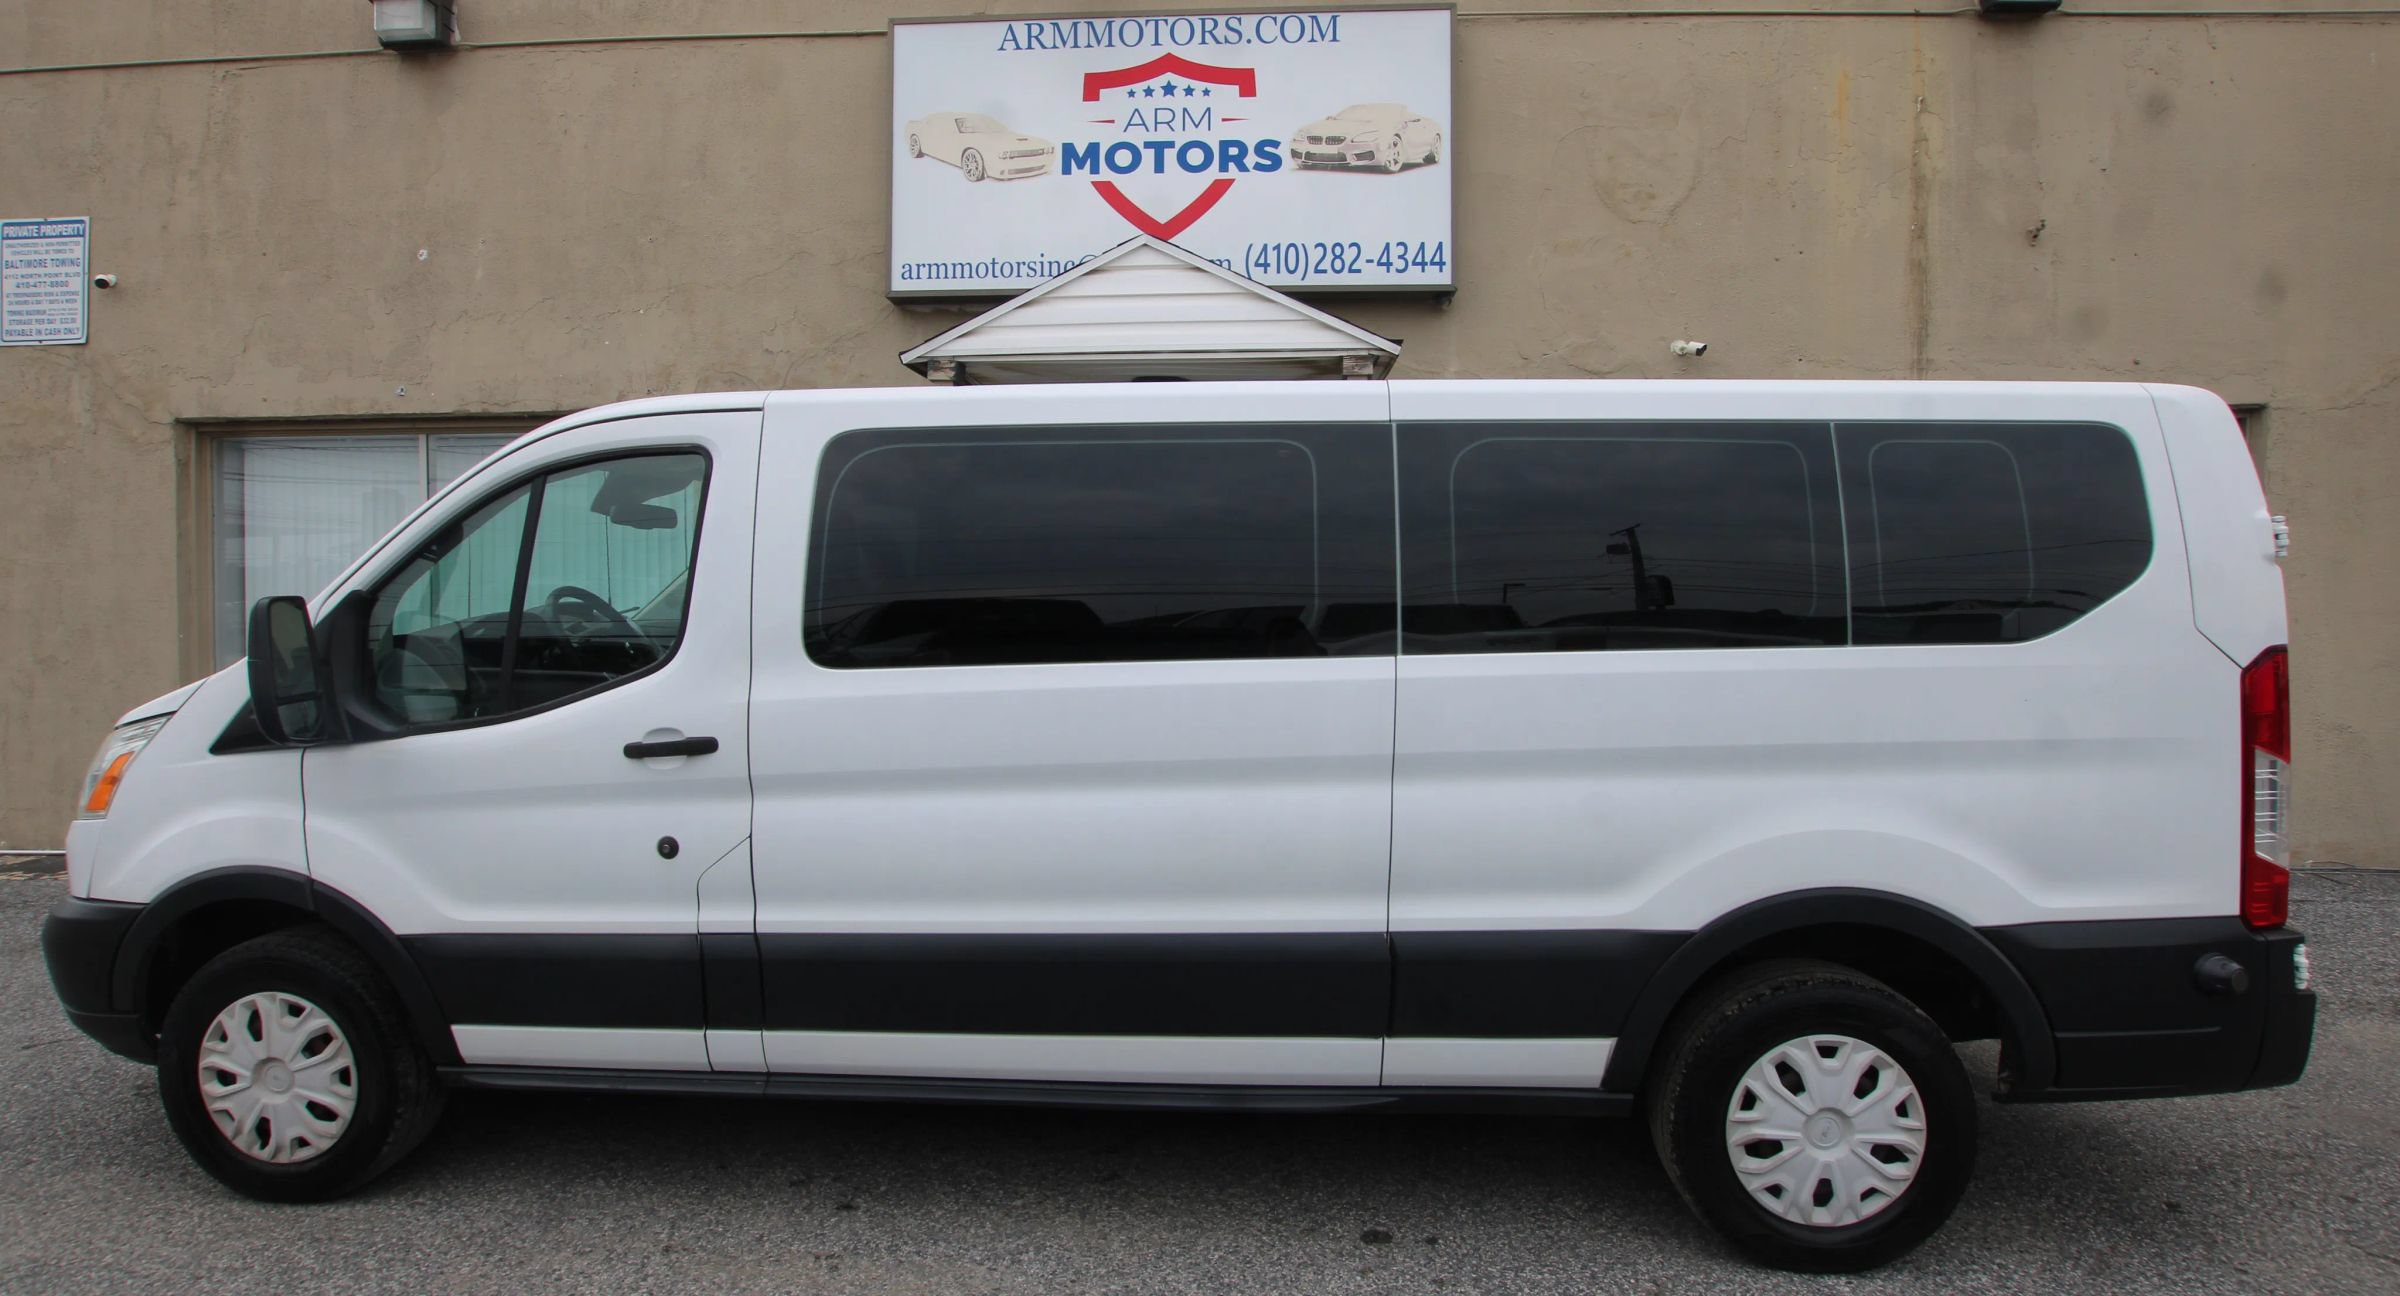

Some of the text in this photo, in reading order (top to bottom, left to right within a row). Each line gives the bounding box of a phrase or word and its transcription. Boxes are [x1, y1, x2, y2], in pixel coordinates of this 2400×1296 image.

[998, 14, 1342, 51] ARMMOTORS.COM
[1123, 106, 1212, 133] ARM
[1061, 138, 1283, 176] MOTORS
[3, 223, 85, 238] PRIVATE PROPERTY
[4, 257, 81, 269] BALTIMORE TOWING
[1244, 241, 1447, 281] (410)282-4344
[5, 327, 80, 336] PAYABLE IN CASH ONLY
